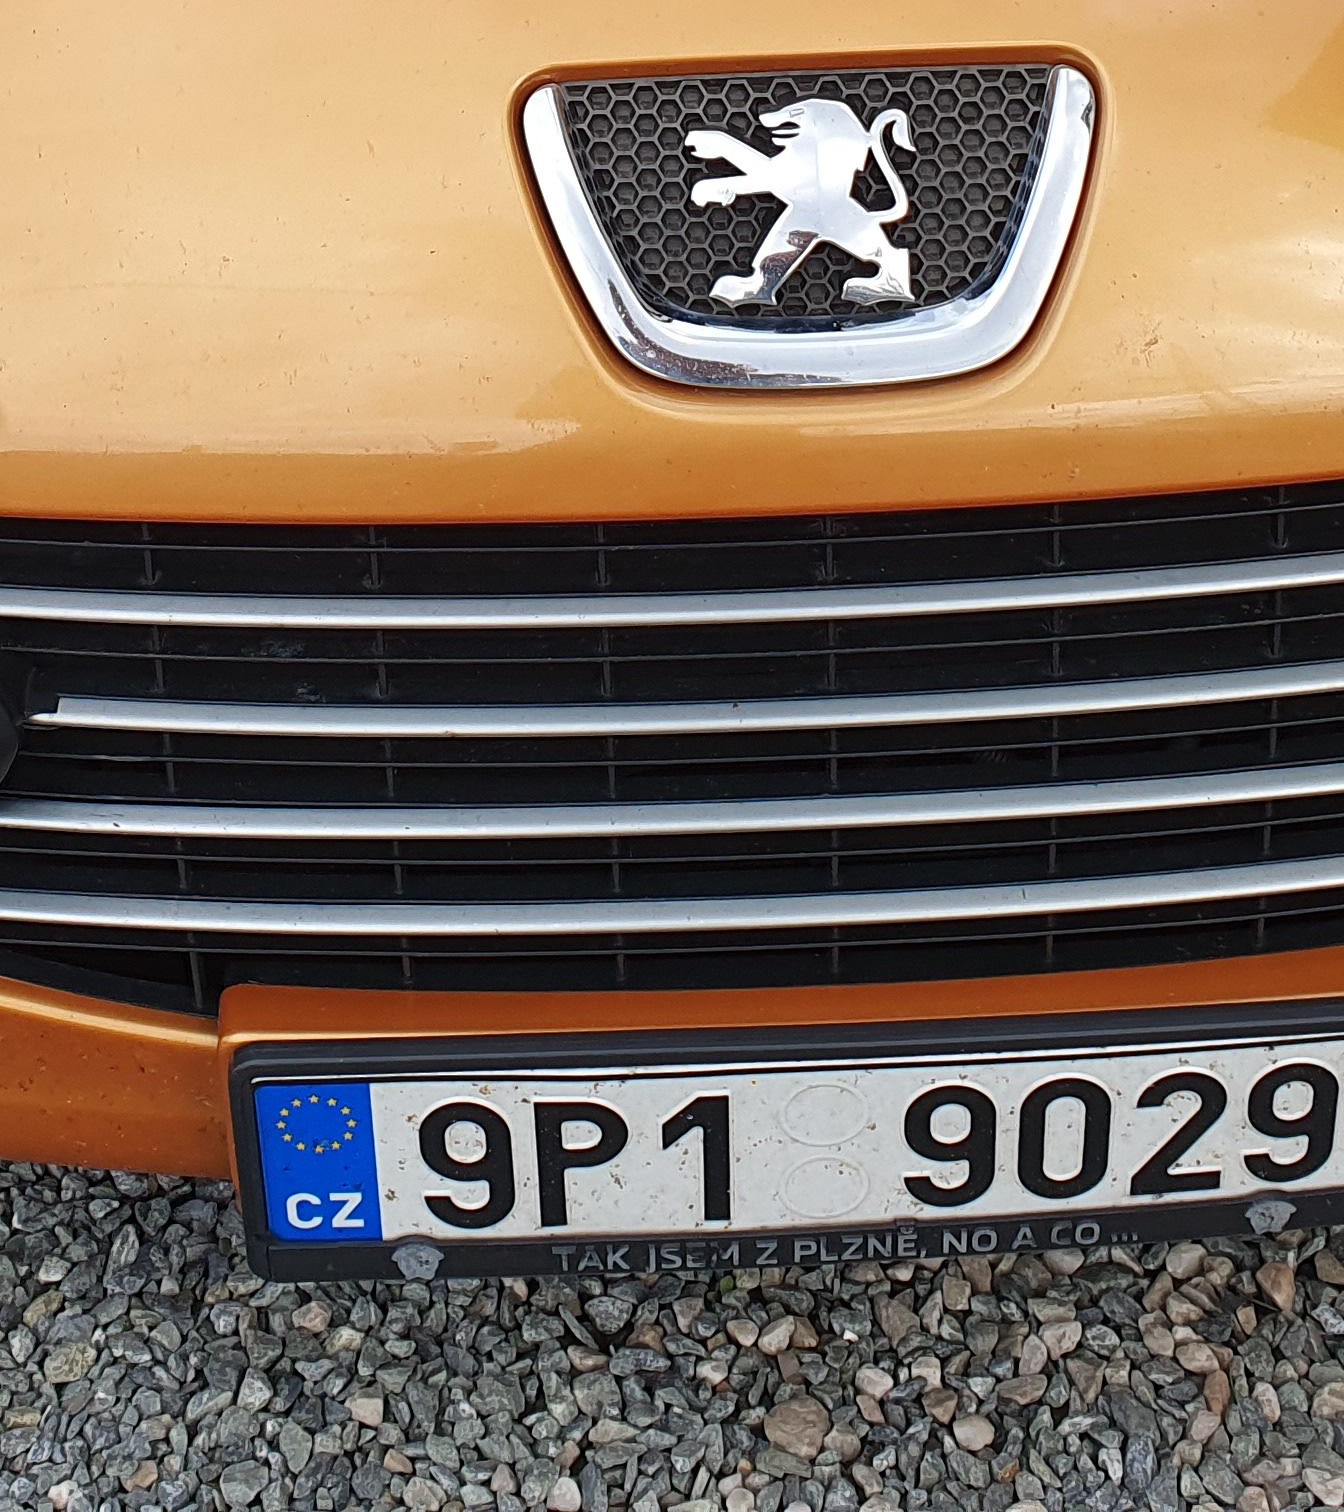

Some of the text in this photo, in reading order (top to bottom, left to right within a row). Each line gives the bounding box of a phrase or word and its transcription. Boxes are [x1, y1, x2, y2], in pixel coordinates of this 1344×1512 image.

[418, 1062, 1340, 1230] 9P1 9029
[285, 1191, 365, 1230] CZ
[551, 1243, 631, 1273] TAK
[644, 1240, 740, 1274] JSEM
[755, 1240, 779, 1265] Z
[942, 1227, 998, 1254] NO
[1010, 1223, 1038, 1249] A
